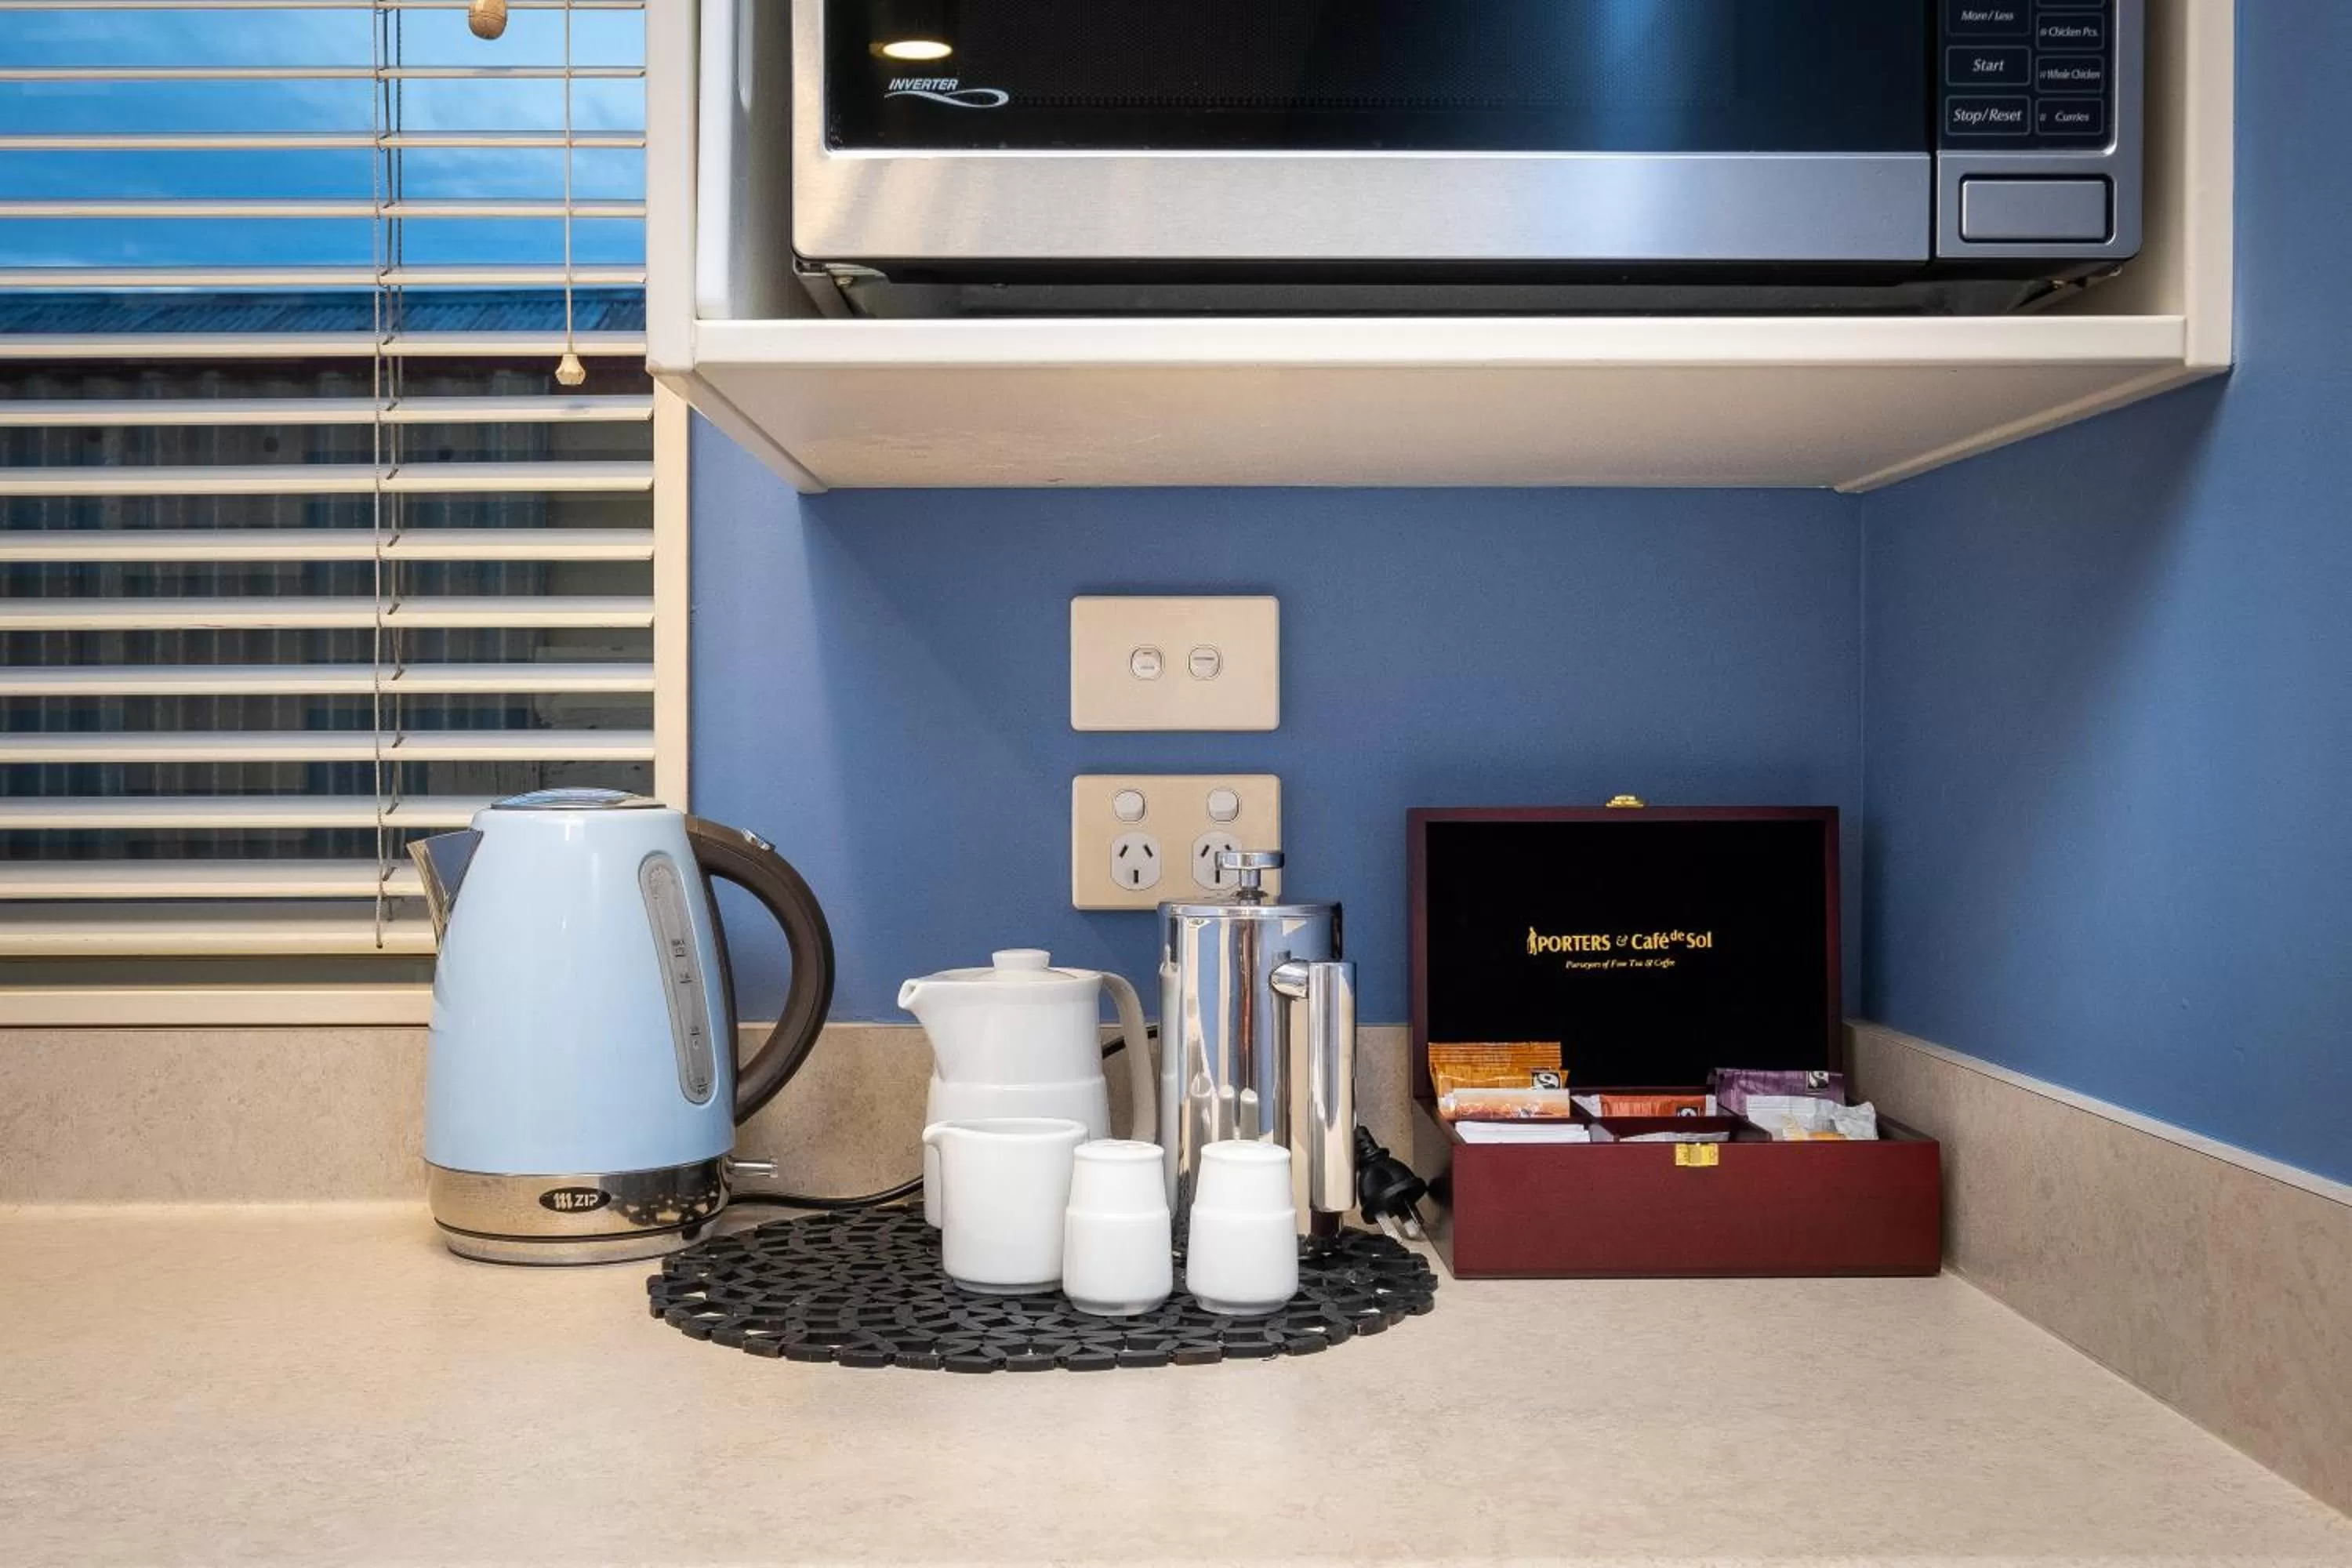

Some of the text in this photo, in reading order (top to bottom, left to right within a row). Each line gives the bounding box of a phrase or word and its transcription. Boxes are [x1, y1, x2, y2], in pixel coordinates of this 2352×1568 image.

[1973, 58, 2005, 72] Start
[888, 78, 958, 91] INVERTER
[2055, 111, 2090, 122] Curries
[1537, 934, 1611, 952] PORTERS
[1631, 931, 1670, 950] Café
[1686, 931, 1714, 949] Sol
[574, 1194, 599, 1207] ZIP
